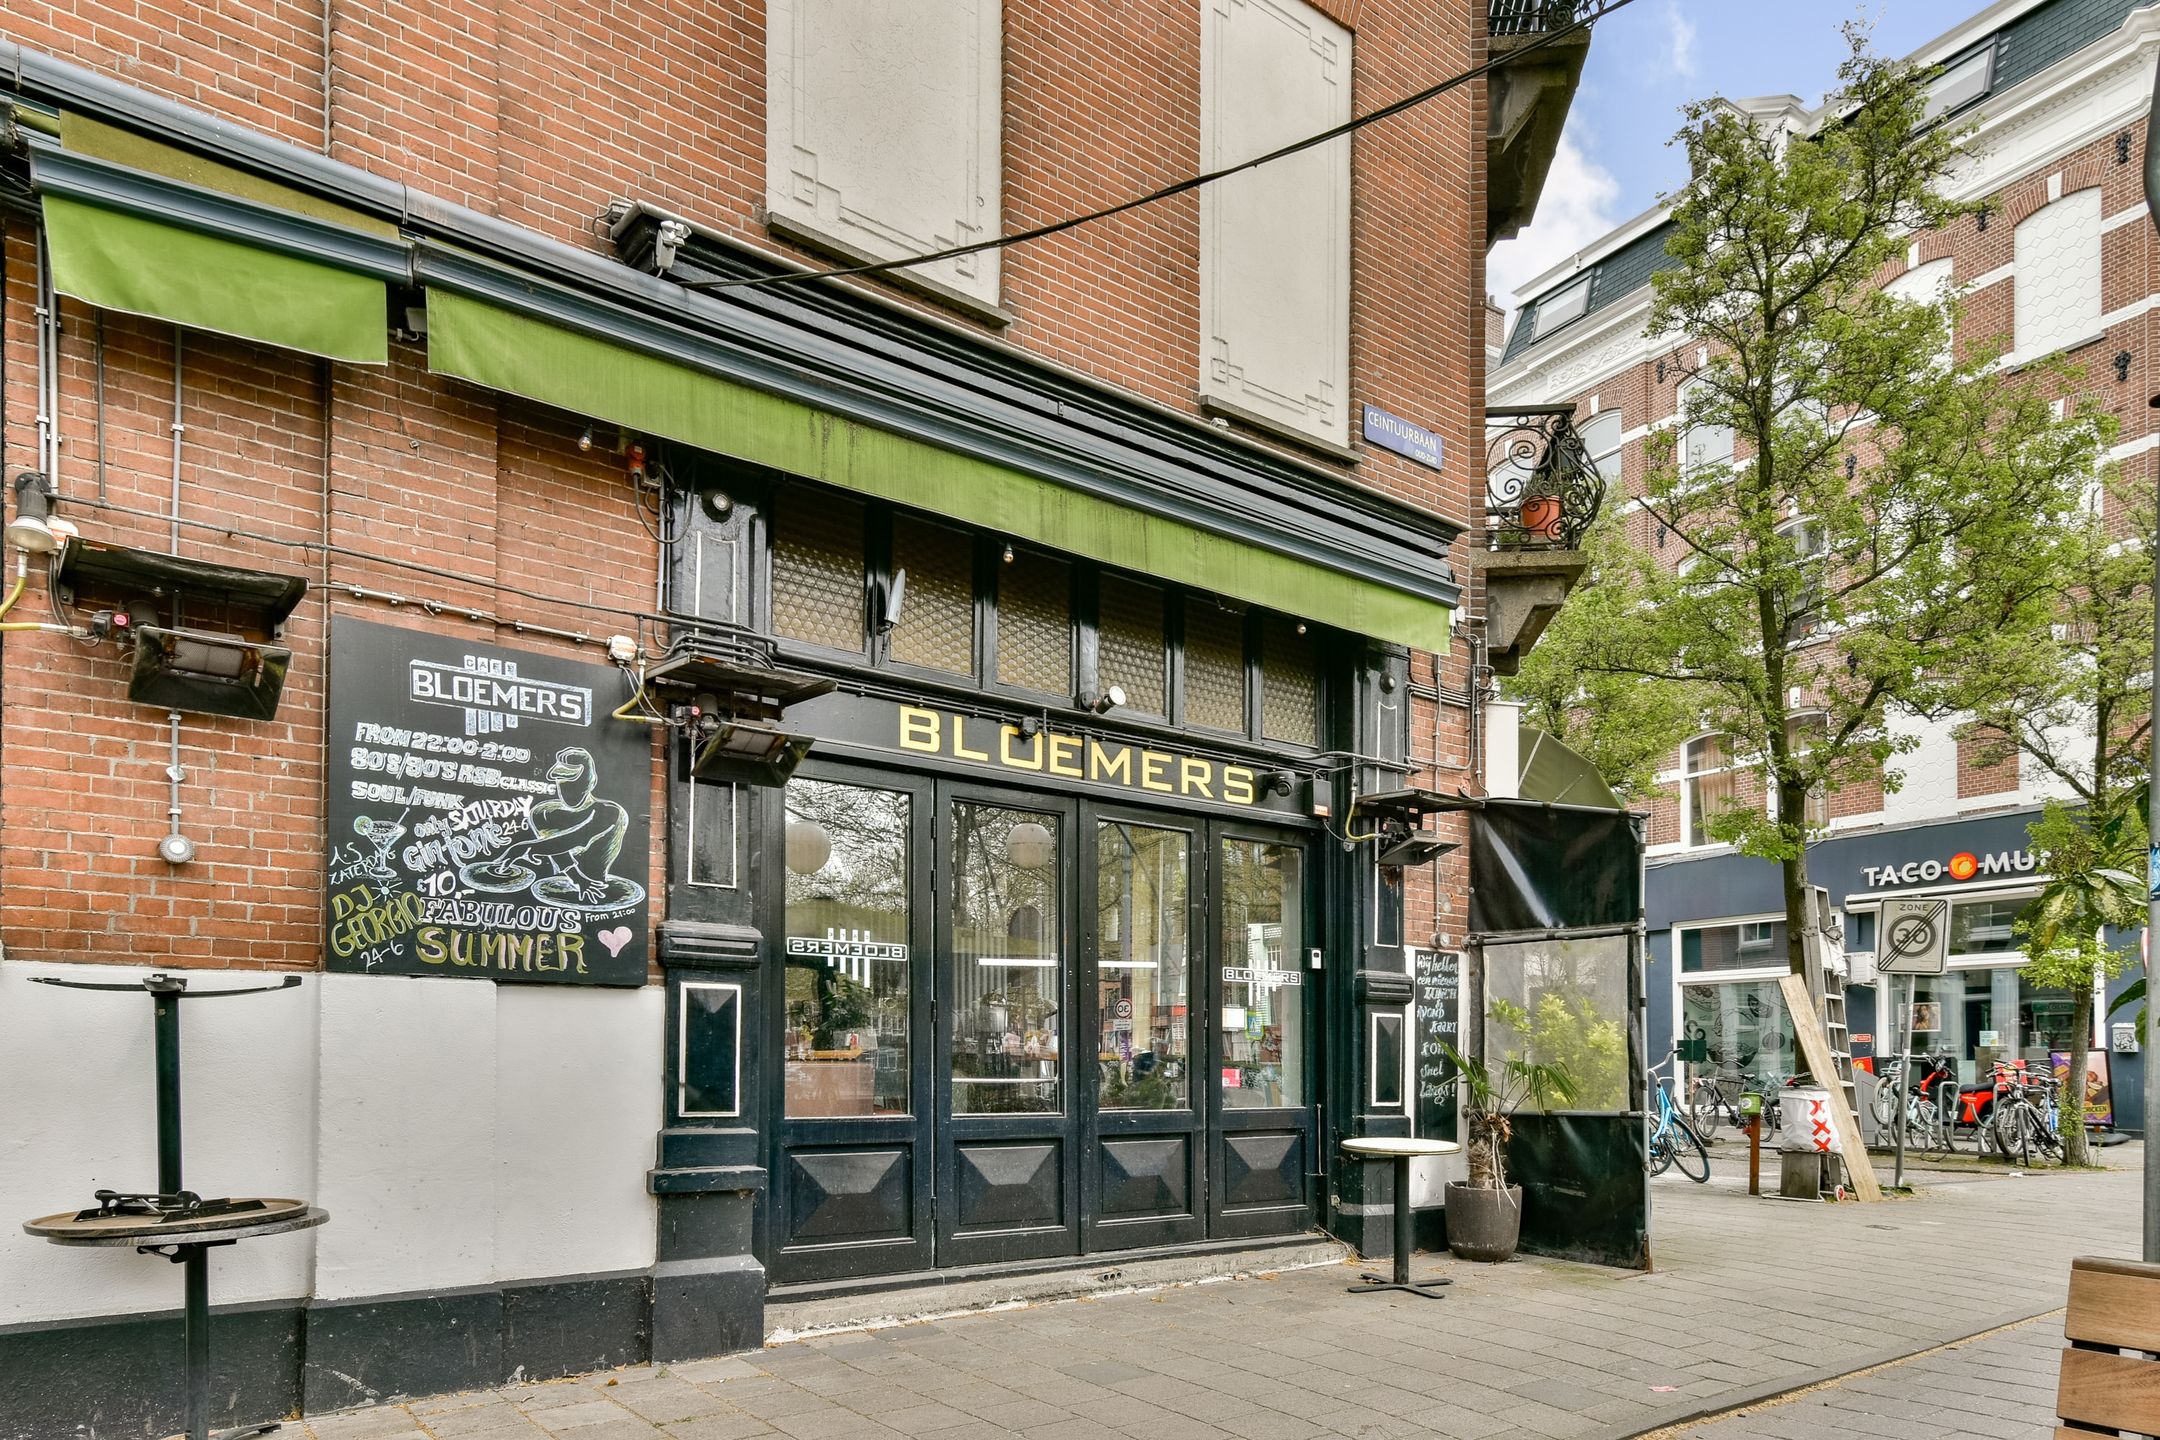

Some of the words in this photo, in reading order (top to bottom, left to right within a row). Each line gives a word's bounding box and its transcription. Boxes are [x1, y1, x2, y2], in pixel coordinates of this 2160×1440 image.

[1368, 411, 1437, 451] CEINTUURBAAN
[412, 668, 583, 720] BLOEMERS
[354, 721, 412, 748] FROM
[899, 704, 1255, 806] BLOEMERS
[448, 794, 534, 831] SATURDAY
[502, 817, 530, 836] 24-6
[1863, 859, 1942, 887] TACO
[331, 883, 374, 921] DJ
[419, 896, 582, 934] FABULOUS
[584, 909, 610, 923] From
[612, 907, 637, 919] 21:00
[1899, 903, 1929, 912] ZONE
[415, 926, 589, 974] SUMMER
[1895, 927, 1929, 945] 30
[360, 939, 405, 974] 24-6
